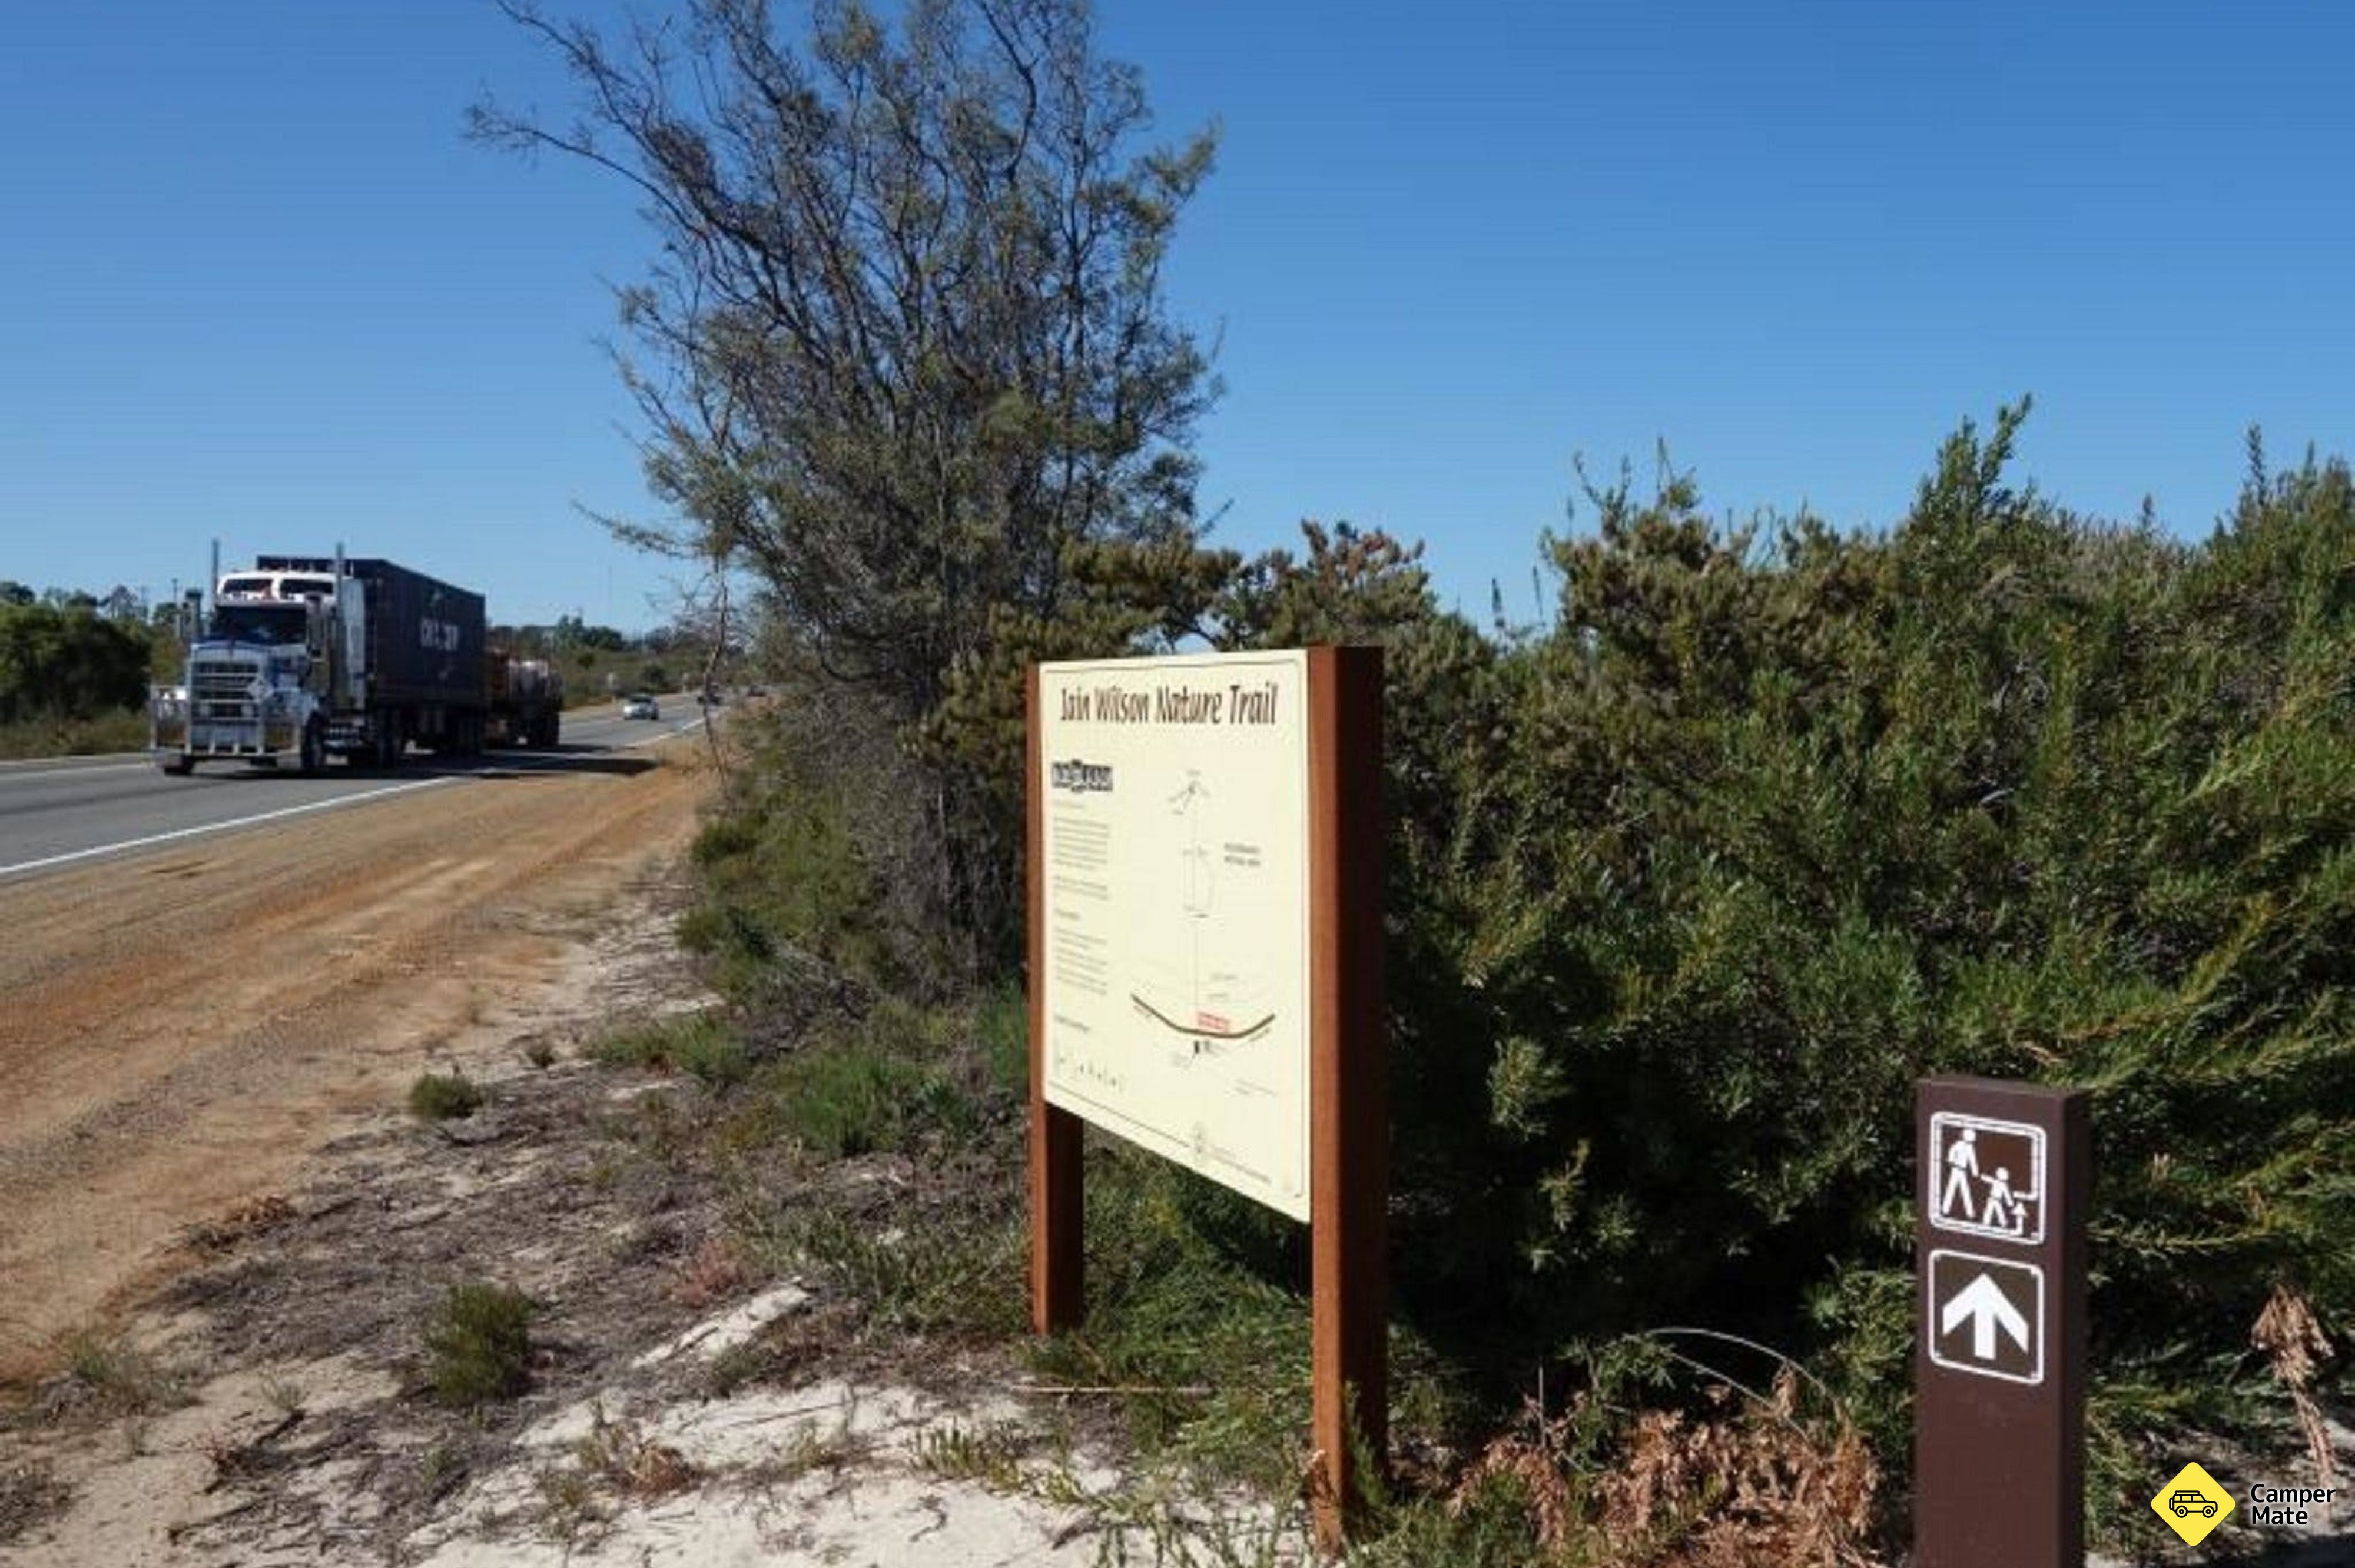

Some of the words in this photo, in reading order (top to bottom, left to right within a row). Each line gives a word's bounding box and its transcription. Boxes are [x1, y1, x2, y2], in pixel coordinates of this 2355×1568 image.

[1060, 686, 1090, 722] Iain
[1094, 685, 1149, 723] Wilson
[1155, 685, 1223, 725] Nature
[1229, 681, 1279, 725] Trail
